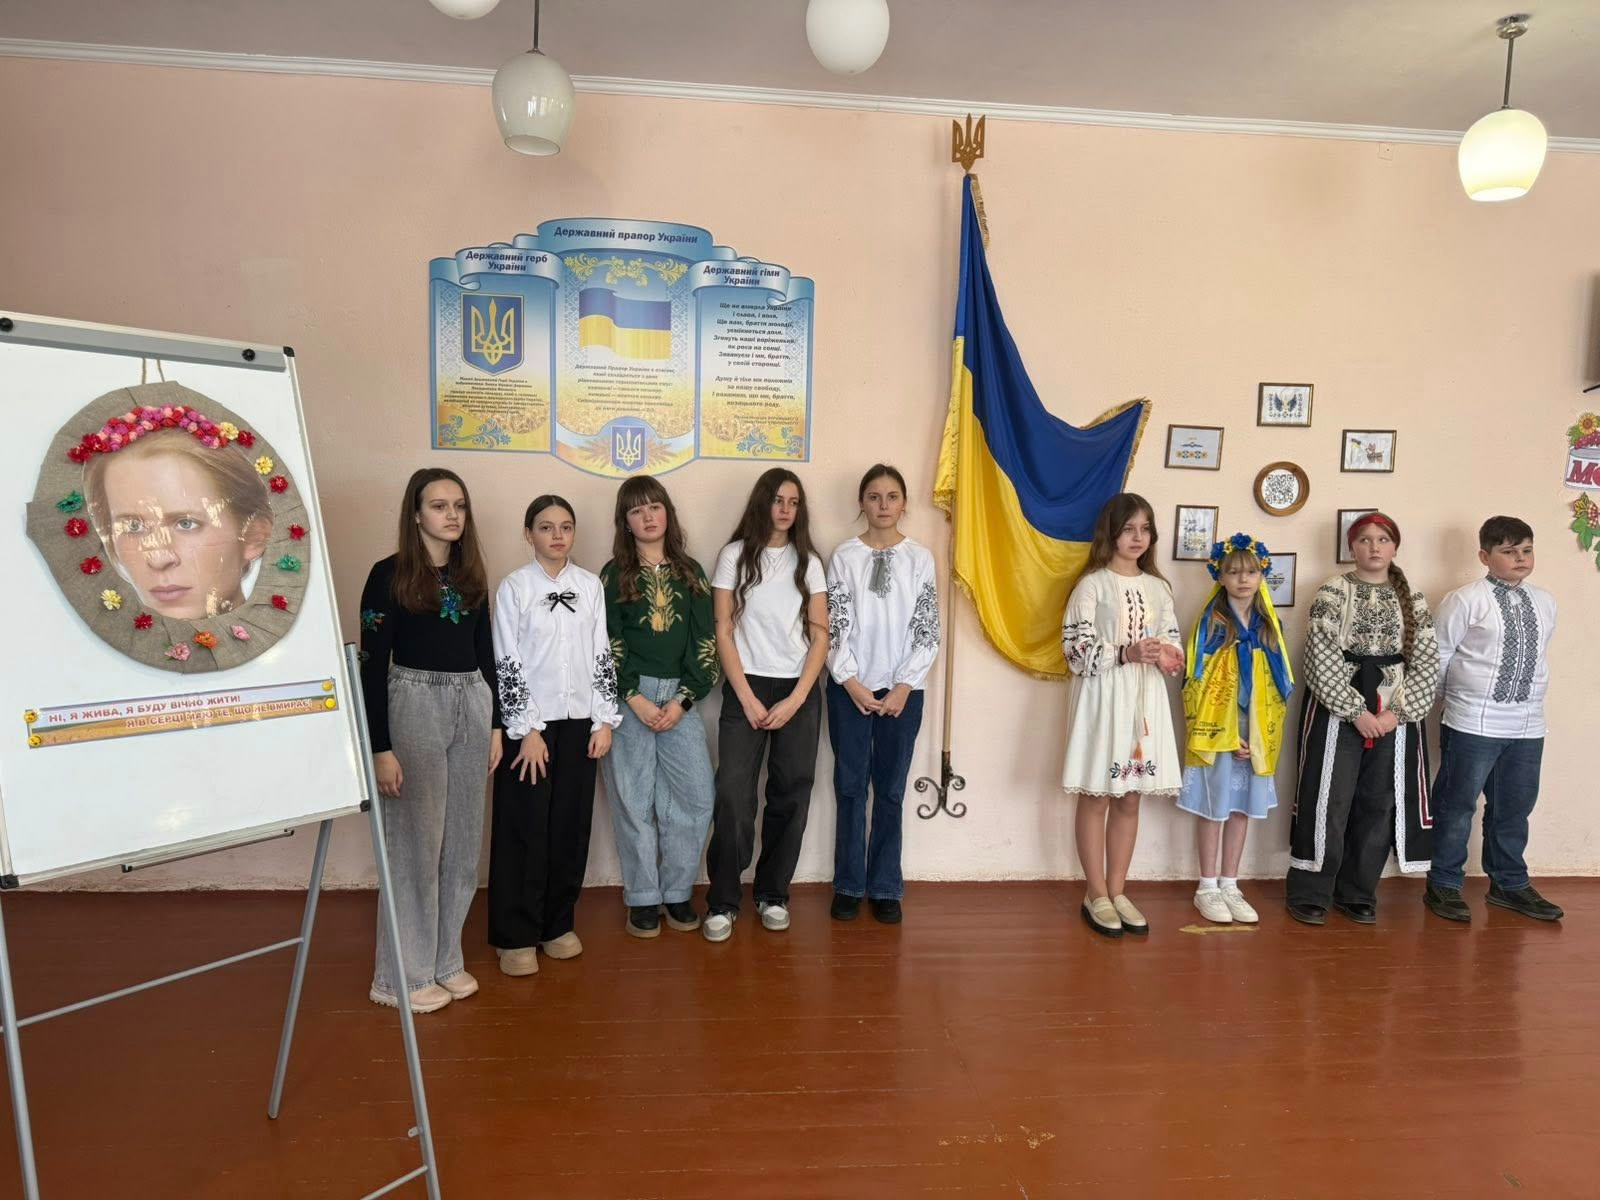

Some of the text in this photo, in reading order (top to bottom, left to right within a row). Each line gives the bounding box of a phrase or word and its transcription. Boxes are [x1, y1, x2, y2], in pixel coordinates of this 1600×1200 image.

[554, 226, 698, 244] Державний прапор України
[465, 251, 548, 264] Державний герб
[488, 262, 526, 272] України
[703, 265, 780, 277] Державний гімн
[723, 275, 760, 286] України
[49, 695, 241, 723] НІ, Я ЖИВА, Я БУДУ ВІЧНО ЖИТИ!
[128, 720, 135, 728] Я
[150, 715, 185, 725] СЕРЦІ
[216, 709, 232, 717] ТЕ,
[235, 706, 250, 716] ЩО
